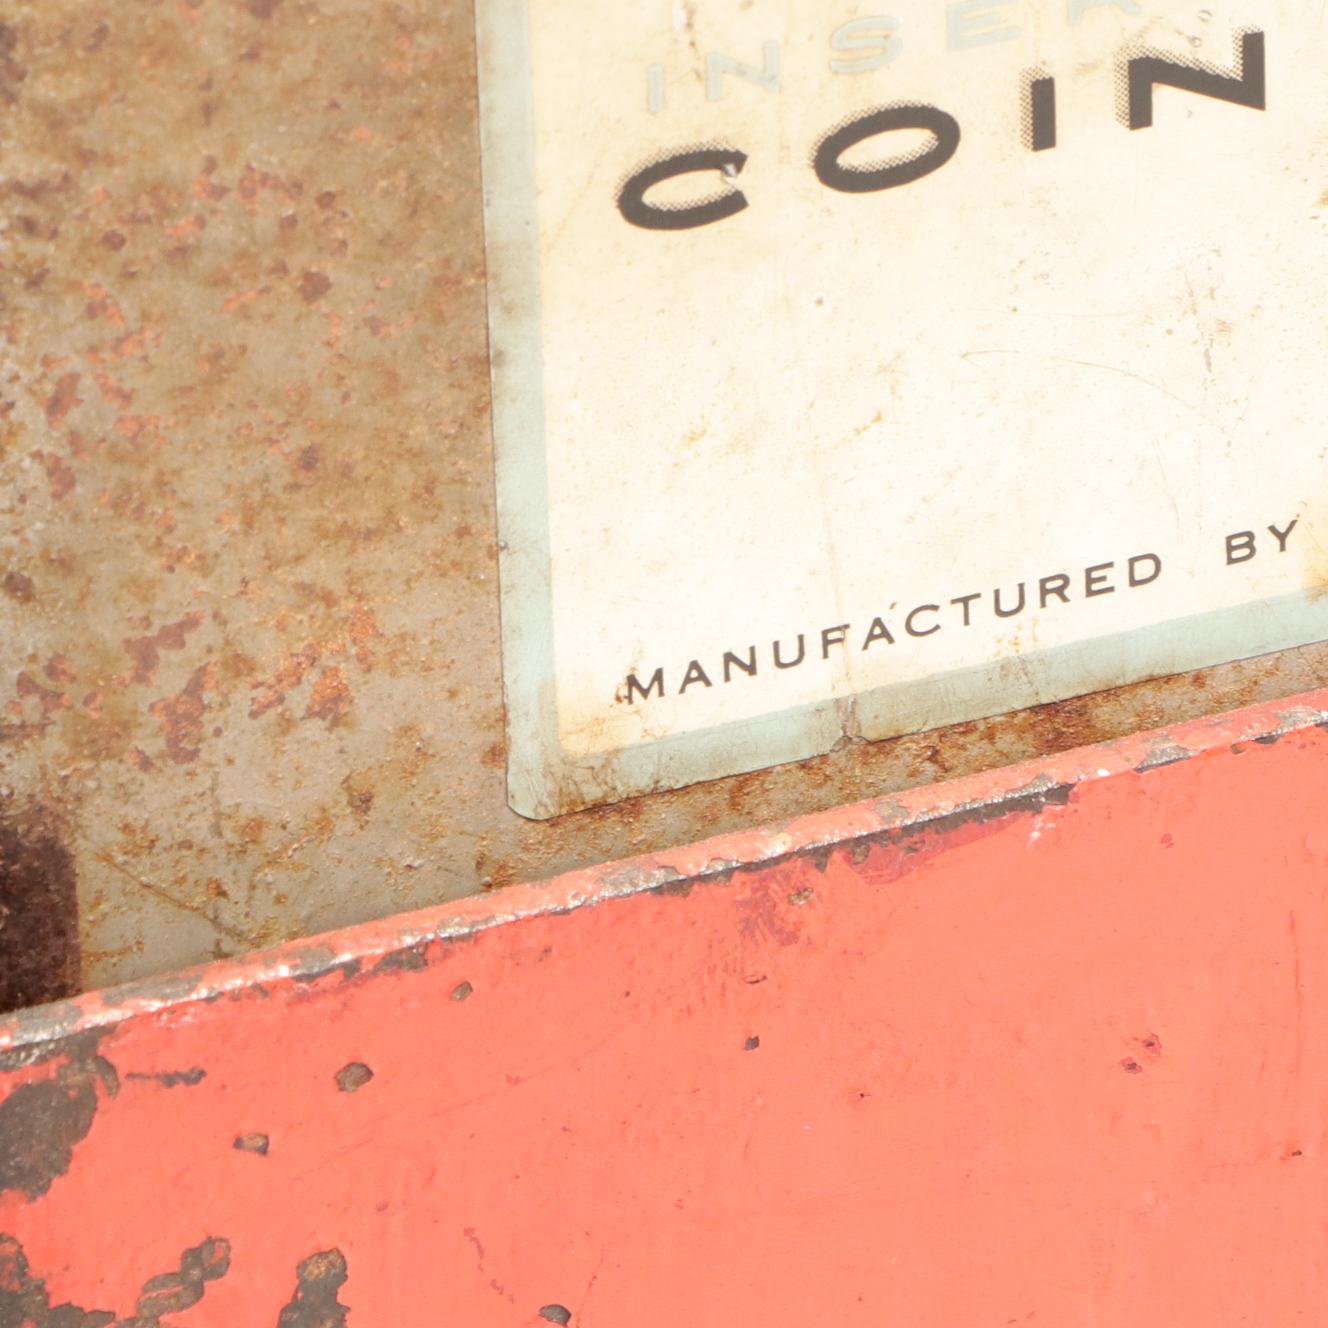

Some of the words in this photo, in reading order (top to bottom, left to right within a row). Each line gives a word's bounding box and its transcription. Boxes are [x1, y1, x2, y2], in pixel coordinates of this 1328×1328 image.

[615, 25, 1266, 231] COIN
[624, 552, 1162, 705] MANUFACTURED
[1224, 519, 1299, 566] BY
